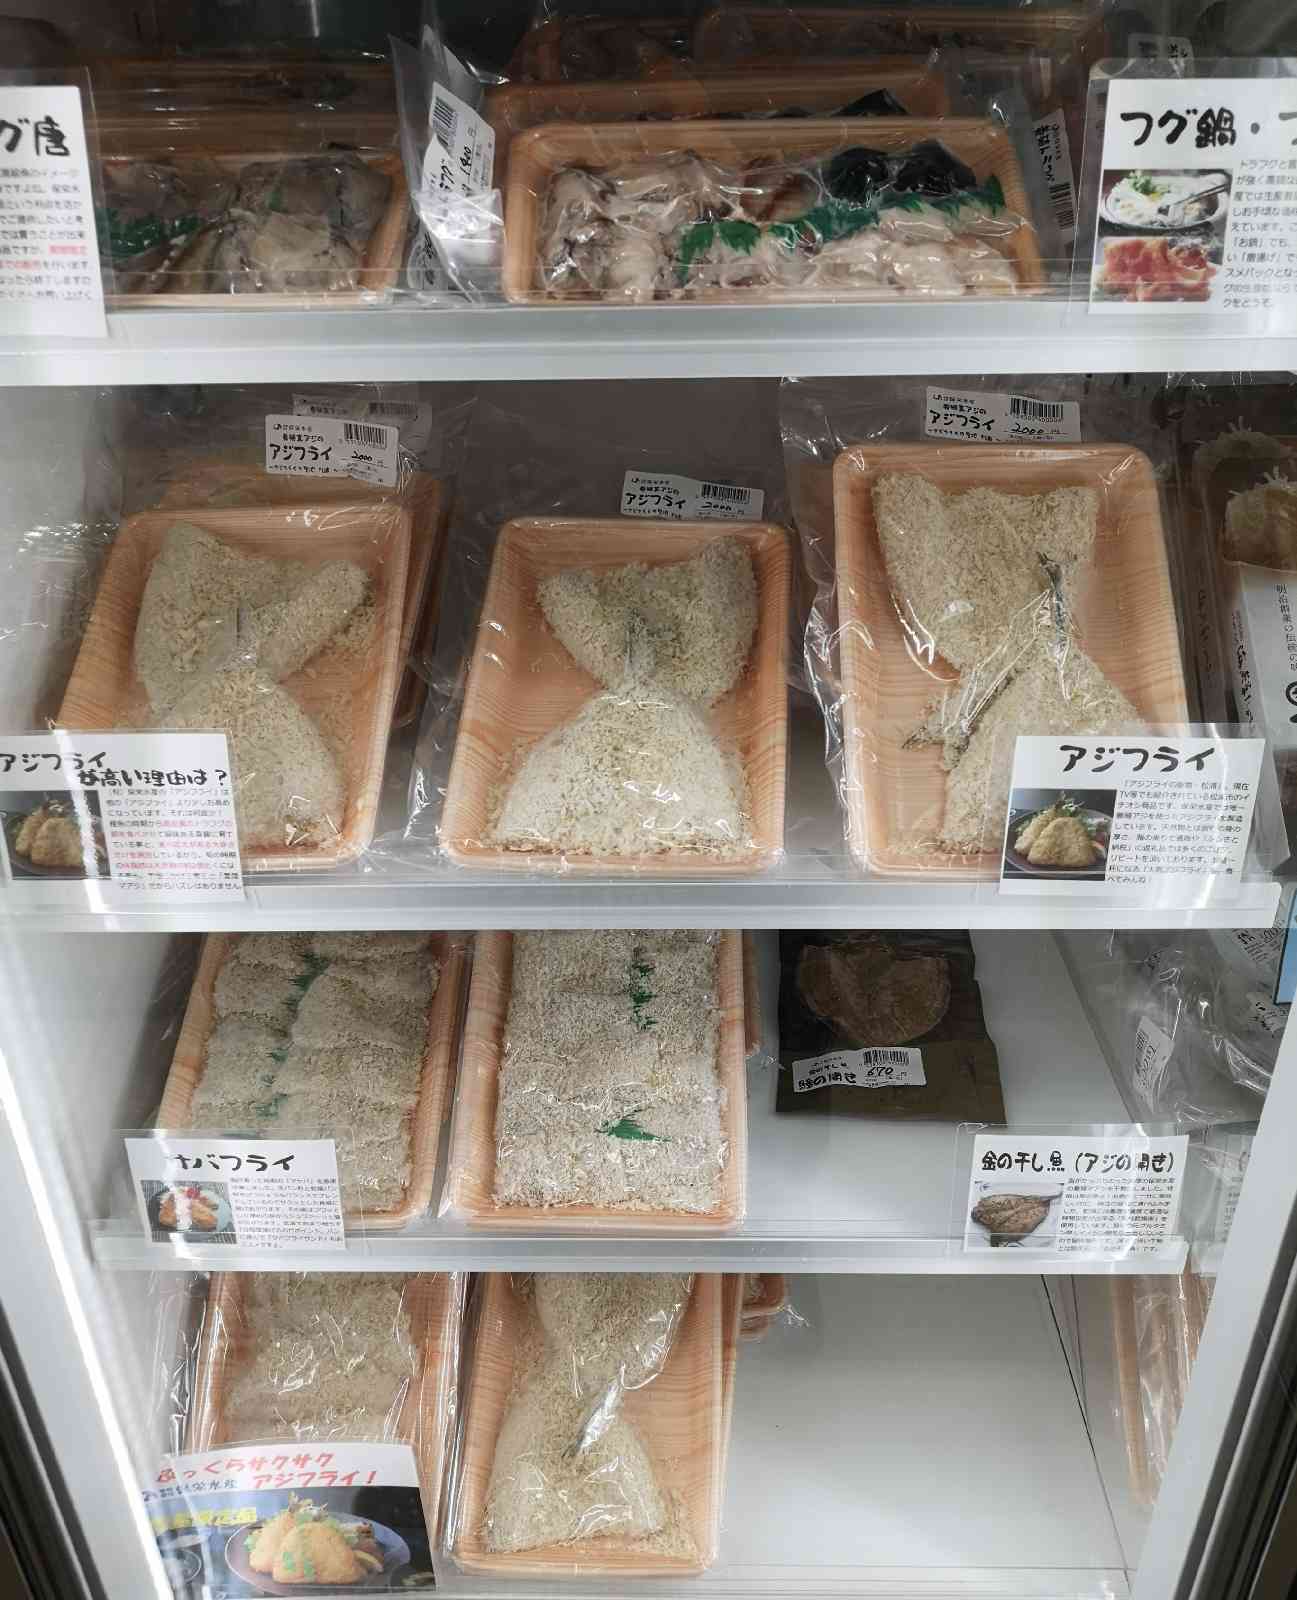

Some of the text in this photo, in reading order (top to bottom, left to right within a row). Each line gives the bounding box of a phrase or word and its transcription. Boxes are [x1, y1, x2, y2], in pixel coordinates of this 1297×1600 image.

[929, 409, 996, 431] アジフライ
[269, 443, 333, 461] アジフライ
[625, 492, 687, 510] アジフライ
[1059, 743, 1216, 773] アジフライ
[77, 768, 229, 787] が高い理由は？
